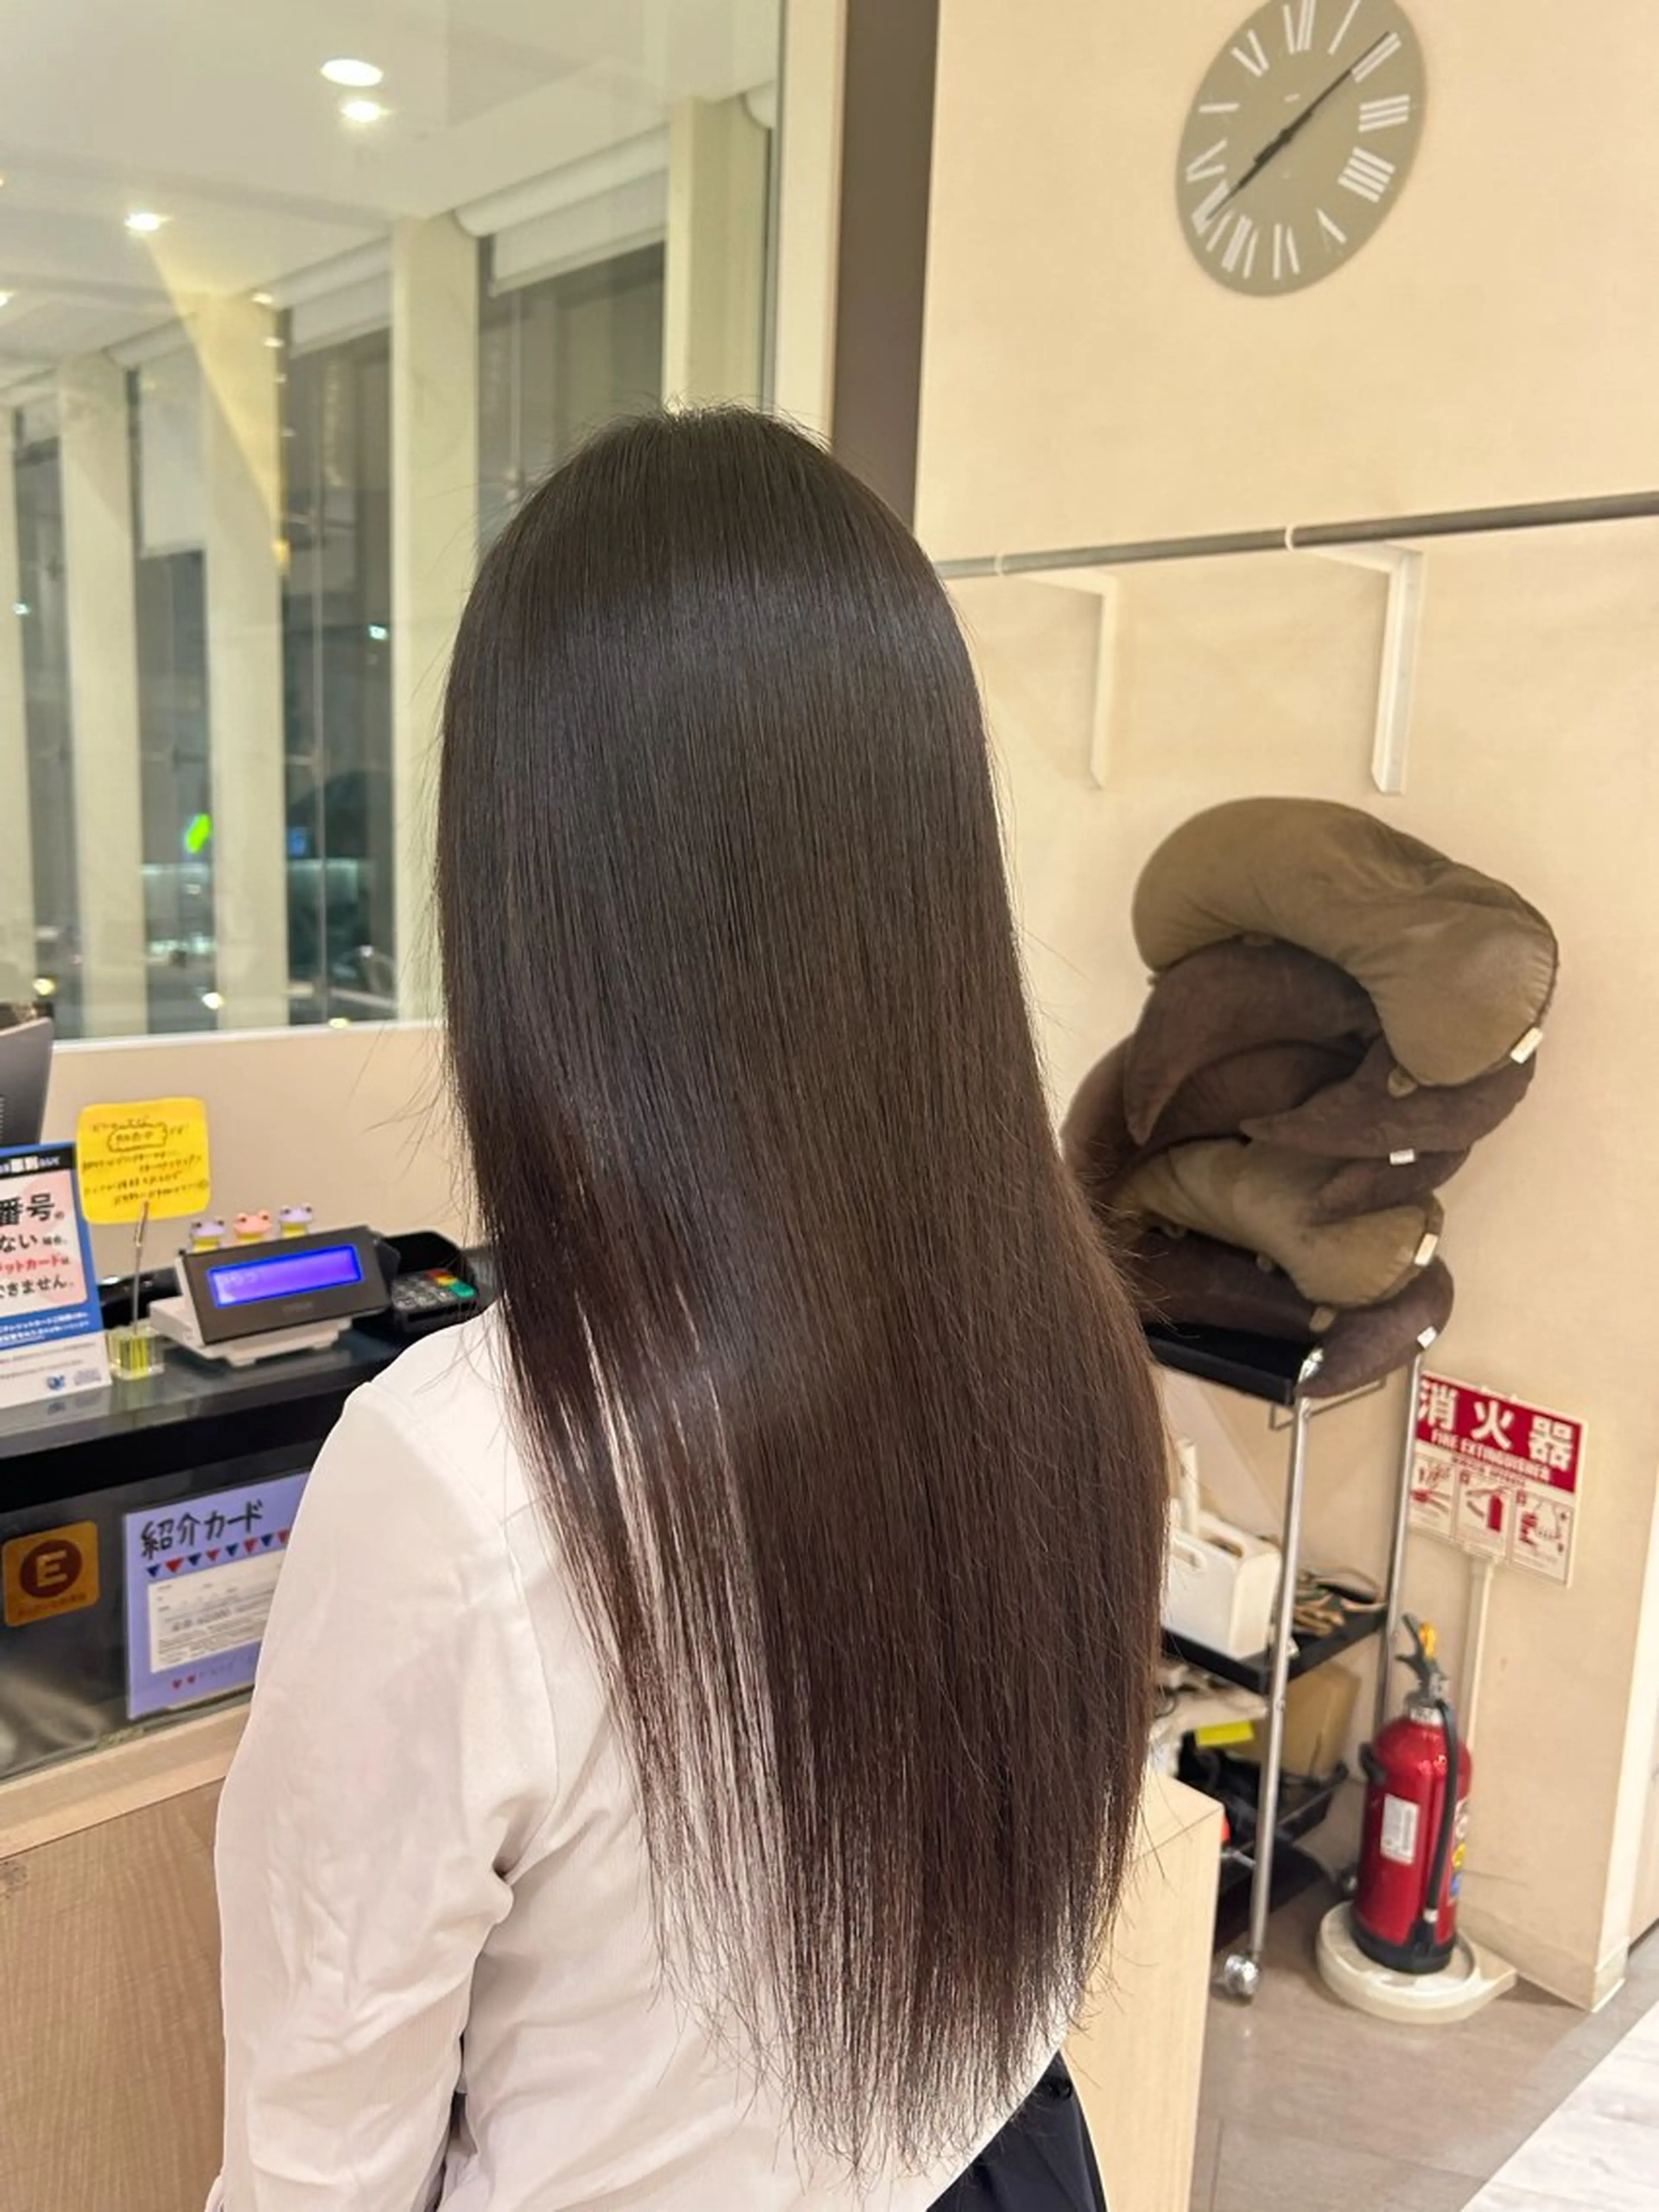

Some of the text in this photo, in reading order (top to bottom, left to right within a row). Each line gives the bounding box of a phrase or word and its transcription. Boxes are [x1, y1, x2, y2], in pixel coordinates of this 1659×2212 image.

[0, 1254, 70, 1274] ットカードは
[1417, 1379, 1573, 1472] 消火器
[141, 1499, 264, 1560] 紹介カード
[35, 1549, 68, 1589] E
